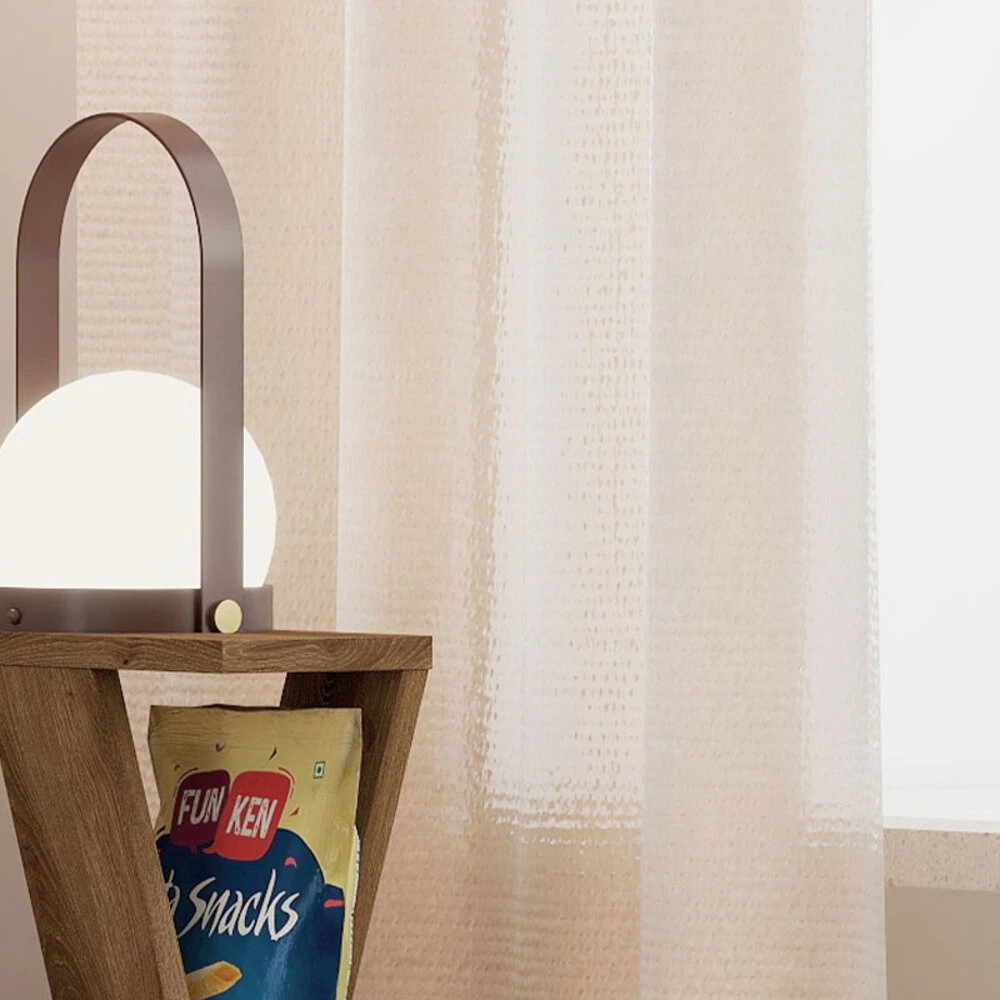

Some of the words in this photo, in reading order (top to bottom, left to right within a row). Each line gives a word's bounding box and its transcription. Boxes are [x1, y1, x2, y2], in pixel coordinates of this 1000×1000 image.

[177, 785, 226, 826] FUN
[225, 794, 278, 840] KEN
[177, 868, 300, 941] Snacks
